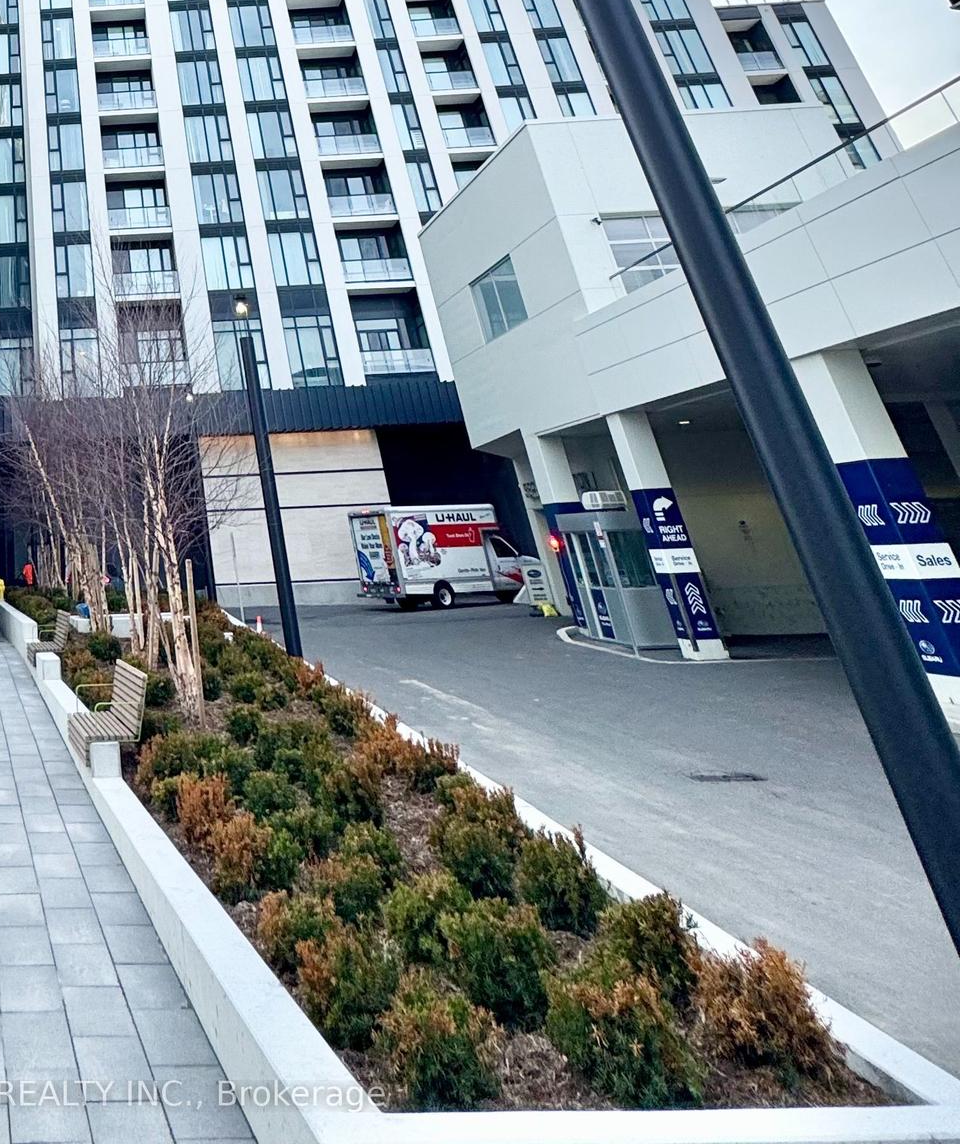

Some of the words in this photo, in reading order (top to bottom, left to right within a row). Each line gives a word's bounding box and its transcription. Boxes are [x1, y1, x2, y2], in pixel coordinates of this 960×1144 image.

[435, 513, 477, 522] U-HAUL
[658, 525, 683, 534] RIGHT
[662, 534, 687, 542] AHEAD
[876, 552, 901, 561] Service
[916, 554, 952, 567] Sales
